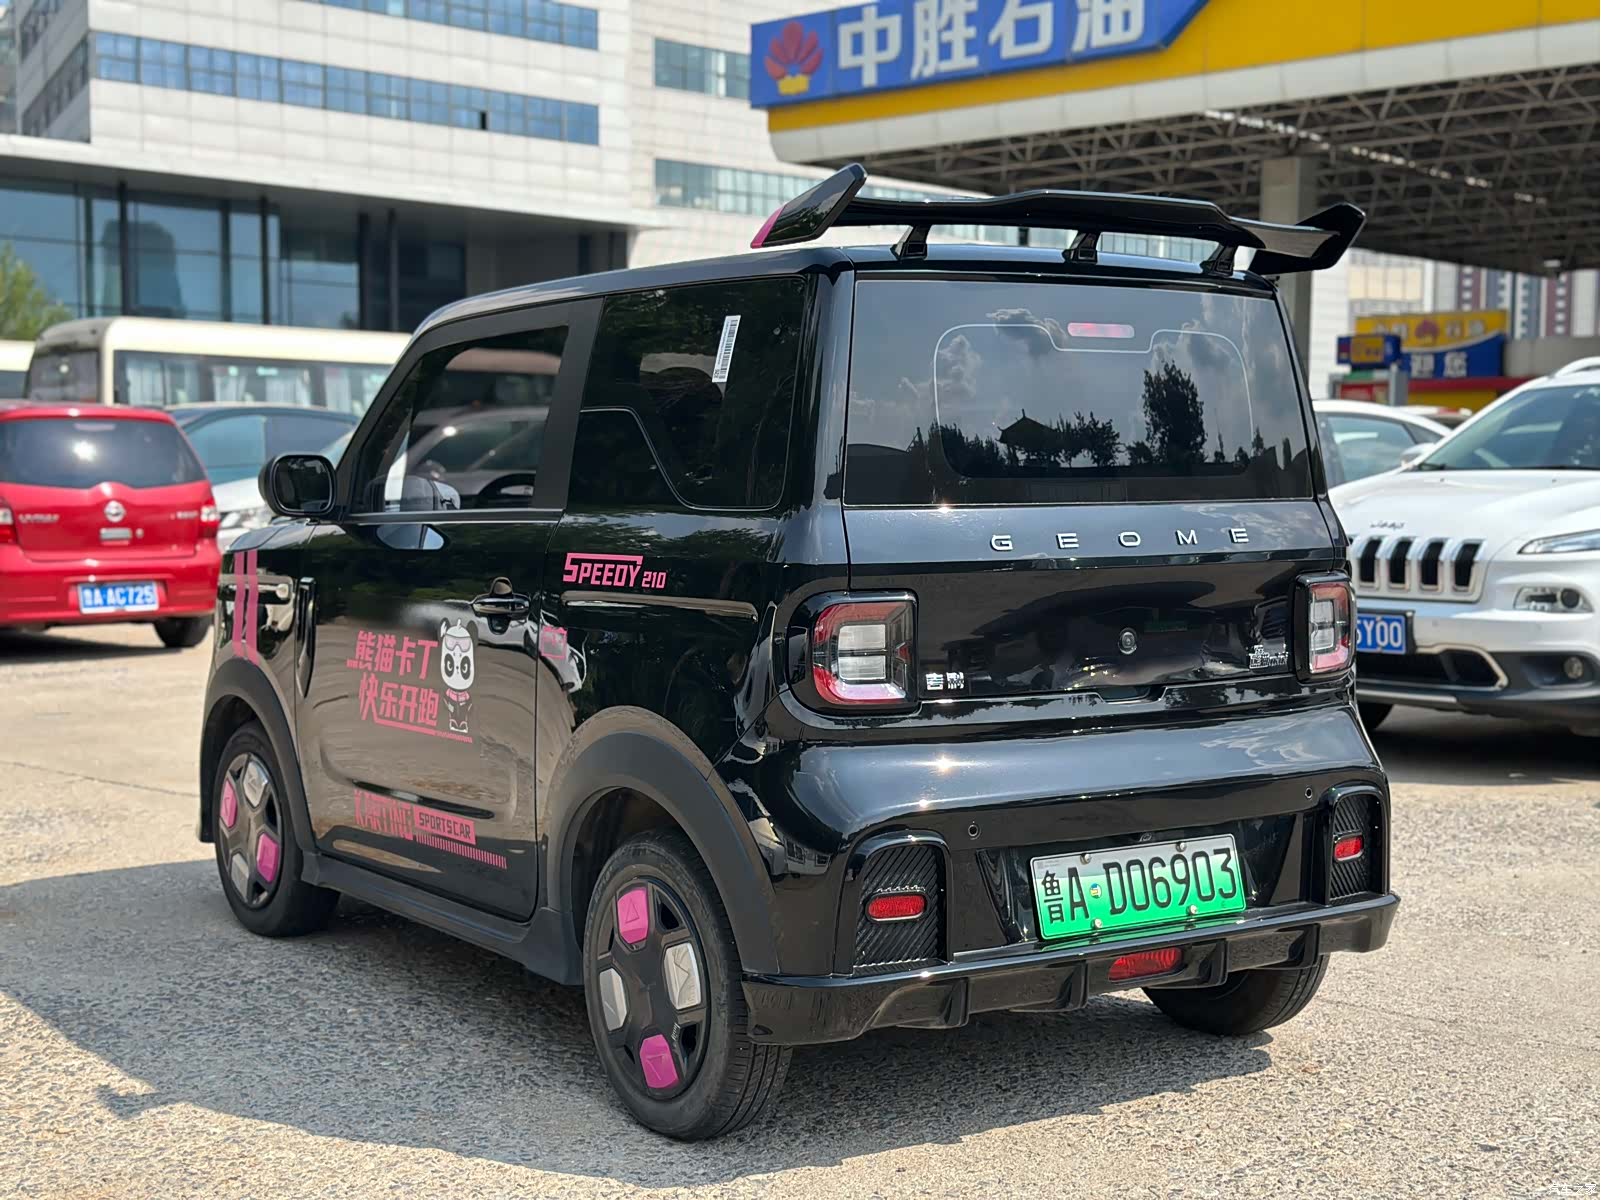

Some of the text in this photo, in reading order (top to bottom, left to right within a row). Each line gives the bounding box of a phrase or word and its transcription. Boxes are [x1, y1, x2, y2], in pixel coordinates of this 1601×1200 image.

[837, 0, 1144, 87] 中胜石油
[991, 527, 1249, 551] GEOME
[563, 552, 667, 588] SPEEDY 210
[346, 630, 439, 680] 熊猫卡丁
[358, 672, 440, 729] 快乐开跑
